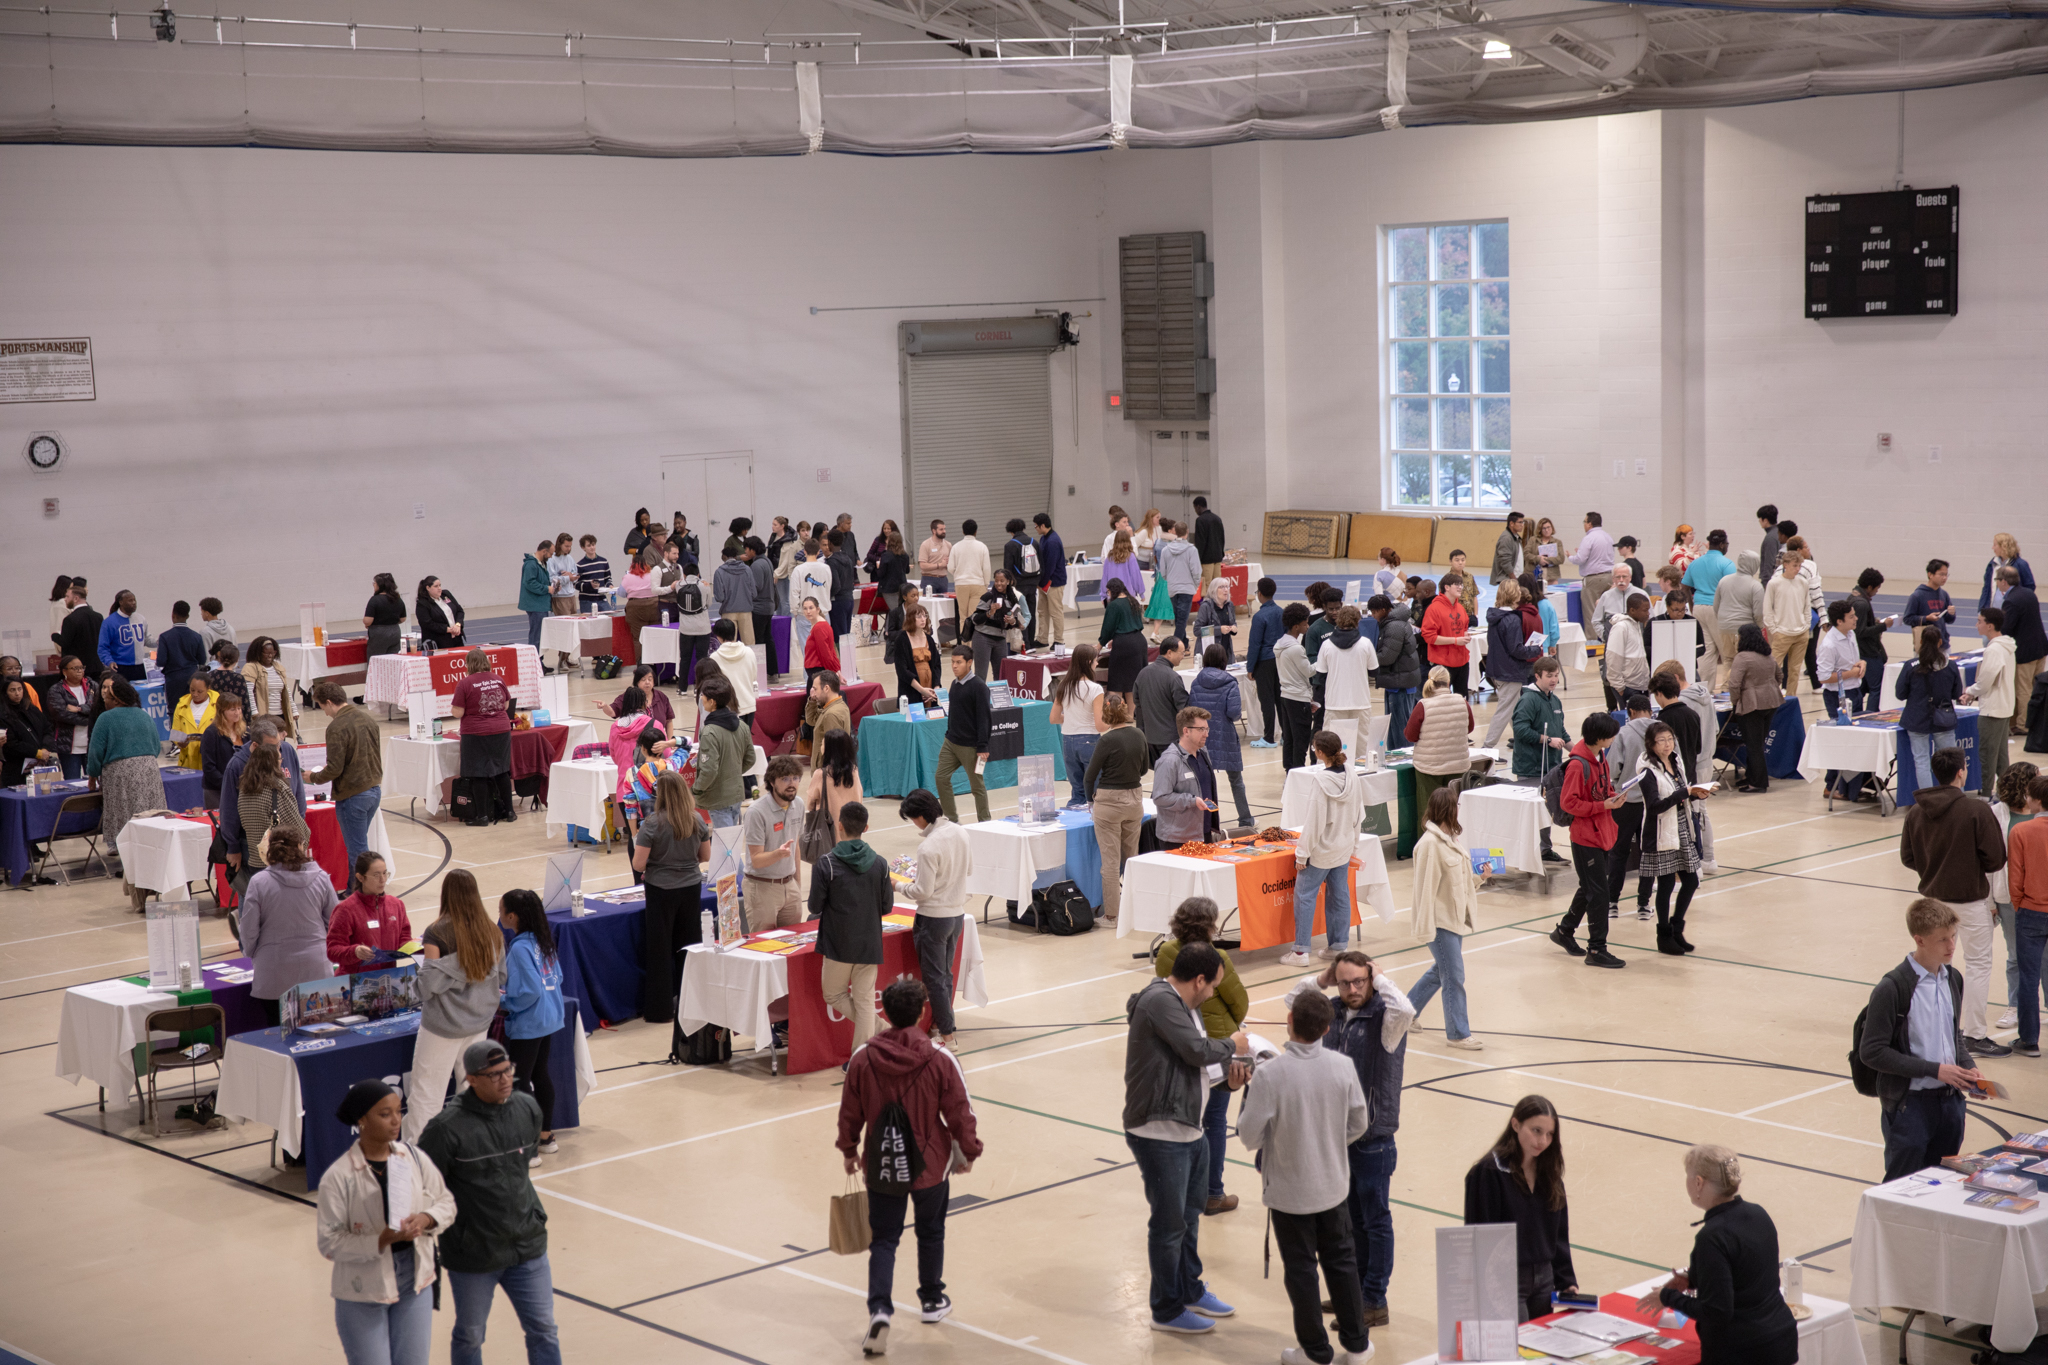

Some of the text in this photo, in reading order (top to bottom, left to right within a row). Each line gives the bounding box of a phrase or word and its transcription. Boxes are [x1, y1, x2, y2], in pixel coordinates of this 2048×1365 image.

[1916, 194, 1947, 207] Guests
[1807, 201, 1841, 213] Westtown
[1862, 239, 1891, 253] period
[1810, 261, 1830, 272] fouls
[1862, 258, 1890, 271] player
[1924, 256, 1946, 267] fouls
[1811, 303, 1827, 312] won
[1865, 301, 1887, 312] game
[1926, 299, 1943, 308] won
[975, 331, 1012, 341] CORNELL
[0, 341, 87, 356] PORTSMANSHIP
[119, 623, 144, 645] CU
[1009, 687, 1037, 700] ELON
[998, 722, 1019, 730] College
[1262, 876, 1296, 894] Occident
[1273, 894, 1284, 906] Los
